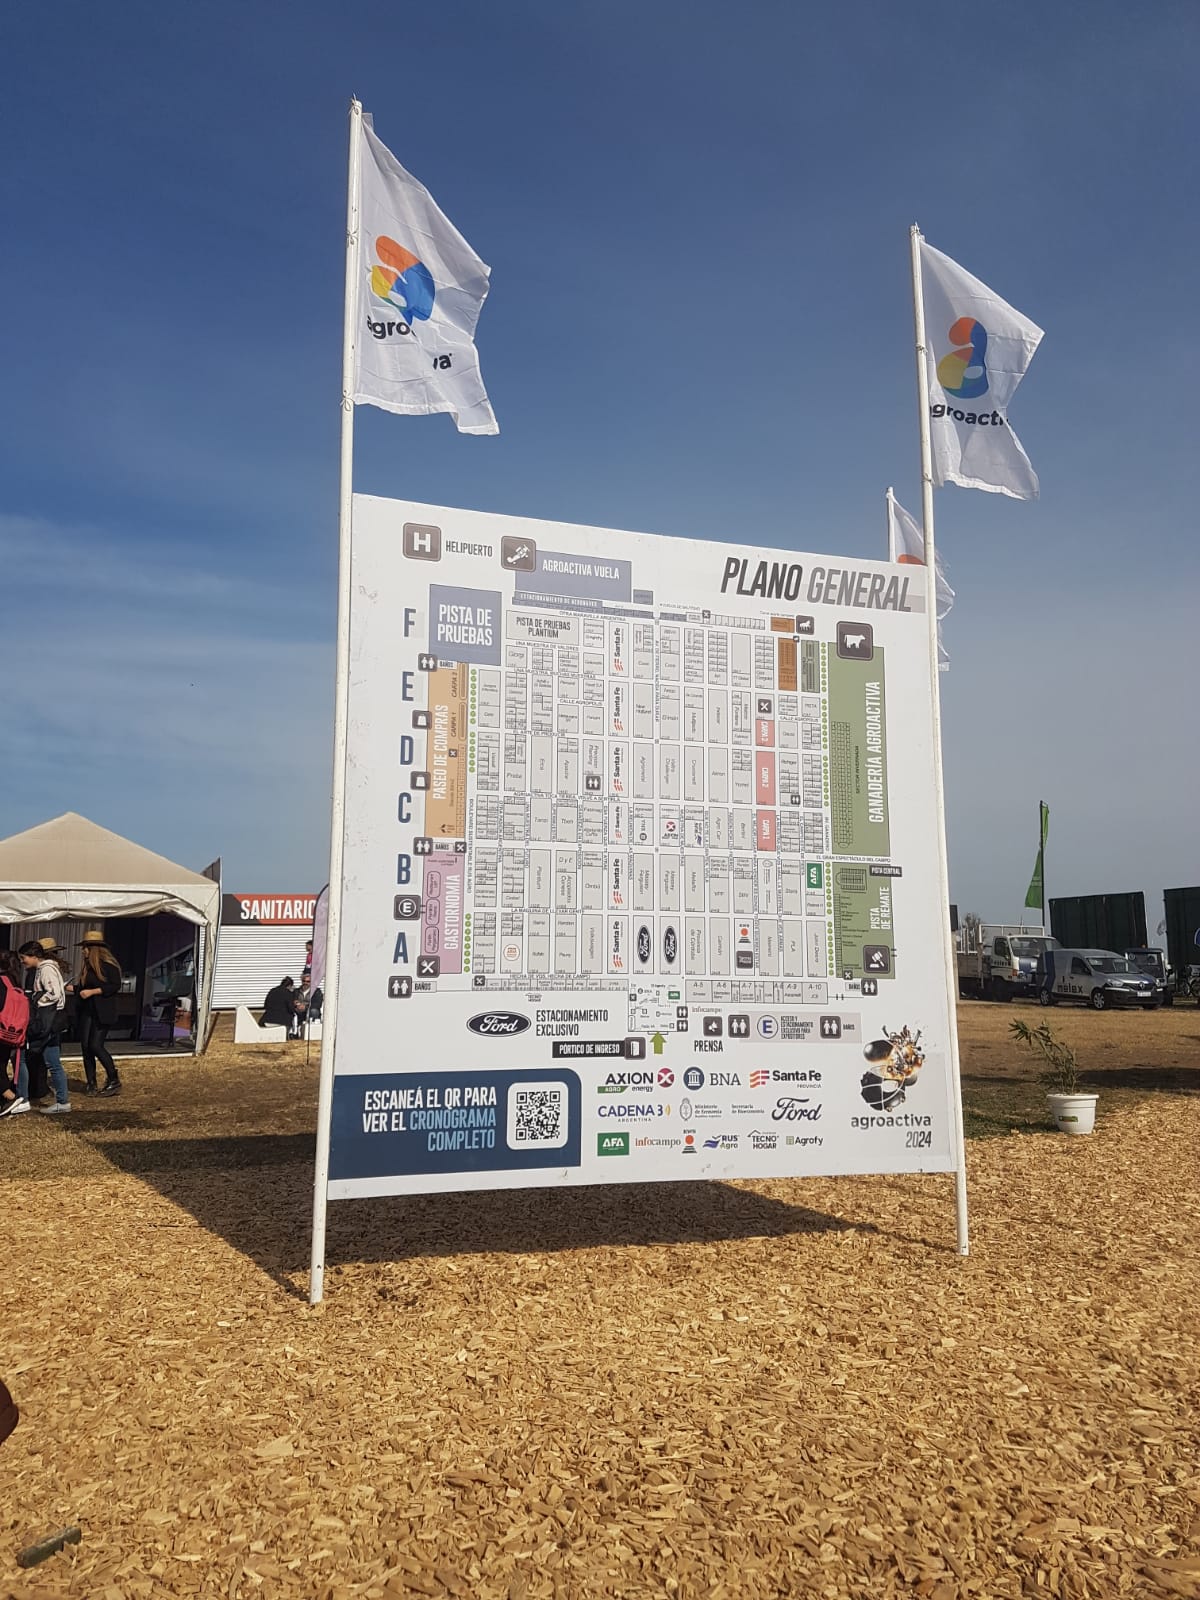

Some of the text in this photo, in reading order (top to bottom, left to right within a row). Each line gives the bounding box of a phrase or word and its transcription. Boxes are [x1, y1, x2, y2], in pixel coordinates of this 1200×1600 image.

[413, 532, 431, 553] H
[445, 541, 493, 558] HELIPUERTO
[542, 559, 620, 580] AGROACTIVA VUELA
[720, 556, 912, 613] PLANO GENERAL
[404, 608, 416, 637] F
[439, 604, 492, 627] PISTA DE
[517, 617, 571, 631] PISTA DE PRUEBAS
[437, 624, 492, 647] PRUEBAS
[528, 628, 559, 639] PLANTIUM
[614, 627, 621, 636] Fe
[401, 671, 414, 701] E
[613, 687, 621, 717] Santa Fe
[400, 735, 414, 765] D
[433, 704, 449, 799] PASEO DE COMPRAS
[865, 682, 884, 823] GANADERÍA AGROACTIVA
[613, 747, 621, 778] Santa Fe
[398, 792, 412, 823] C
[397, 854, 411, 885] B
[613, 858, 620, 867] Fe
[402, 903, 412, 914] E
[443, 874, 460, 950] GASTORNOMÍA
[870, 907, 881, 929] PISTA
[880, 886, 890, 930] DE REMATE
[612, 921, 620, 953] Santa Fe
[639, 932, 649, 957] Ford
[665, 933, 675, 957] Ford
[393, 932, 408, 964] A
[479, 1014, 519, 1033] Ford
[536, 1009, 608, 1022] ESTACIONAMIENTO
[536, 1023, 579, 1036] EXCLUSIVO
[762, 1020, 773, 1034] E
[559, 1043, 620, 1055] PÓRTICO DE INGRESO
[694, 1040, 724, 1052] PRENSA
[605, 1072, 654, 1085] AXION
[709, 1073, 742, 1086] BNA
[772, 1070, 822, 1082] Santa Fe
[364, 1086, 497, 1111] ESCANEÁ EL QR PARA
[772, 1097, 823, 1121] Ford
[362, 1108, 497, 1133] VER EL CRONOGRAMA
[598, 1104, 664, 1118] CADENA 3
[851, 1114, 931, 1130] agroactiva
[427, 1129, 495, 1152] COMPLETO
[603, 1137, 625, 1147] AFA
[635, 1136, 681, 1148] infocampo
[752, 1142, 777, 1150] HOGAR
[794, 1136, 824, 1146] Agrofy
[905, 1130, 932, 1148] 2024
